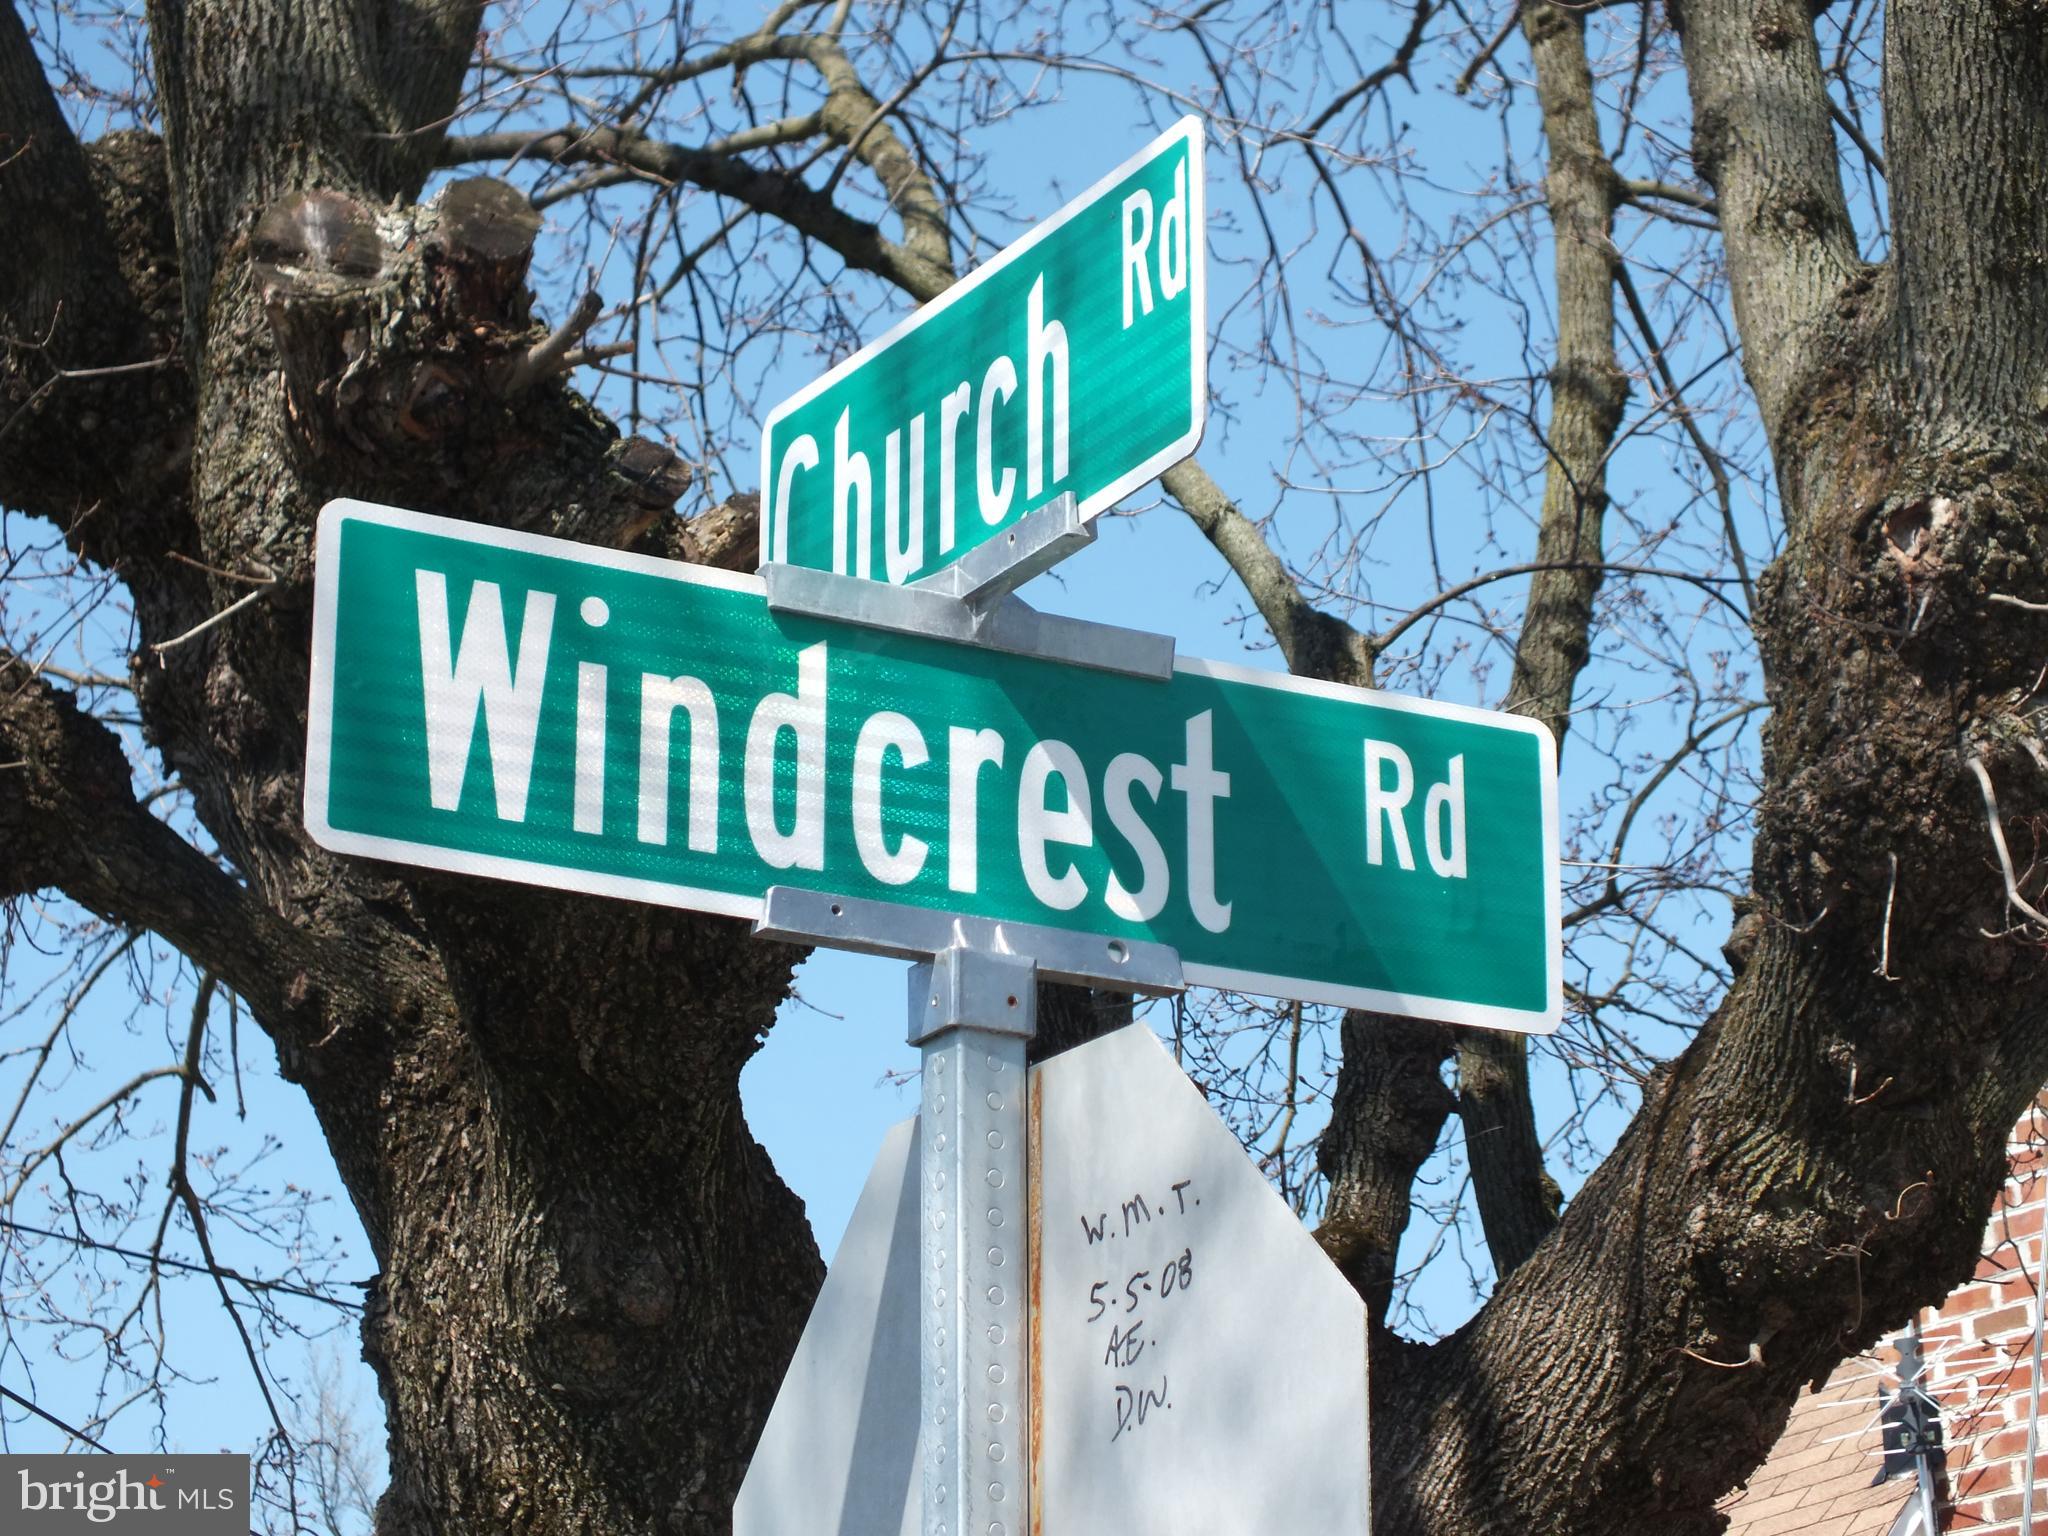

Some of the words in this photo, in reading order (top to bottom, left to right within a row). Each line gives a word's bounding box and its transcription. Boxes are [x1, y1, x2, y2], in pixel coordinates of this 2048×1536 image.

[1122, 155, 1188, 330] Rd
[414, 568, 1233, 934] Windcrest
[1363, 738, 1468, 879] Rd
